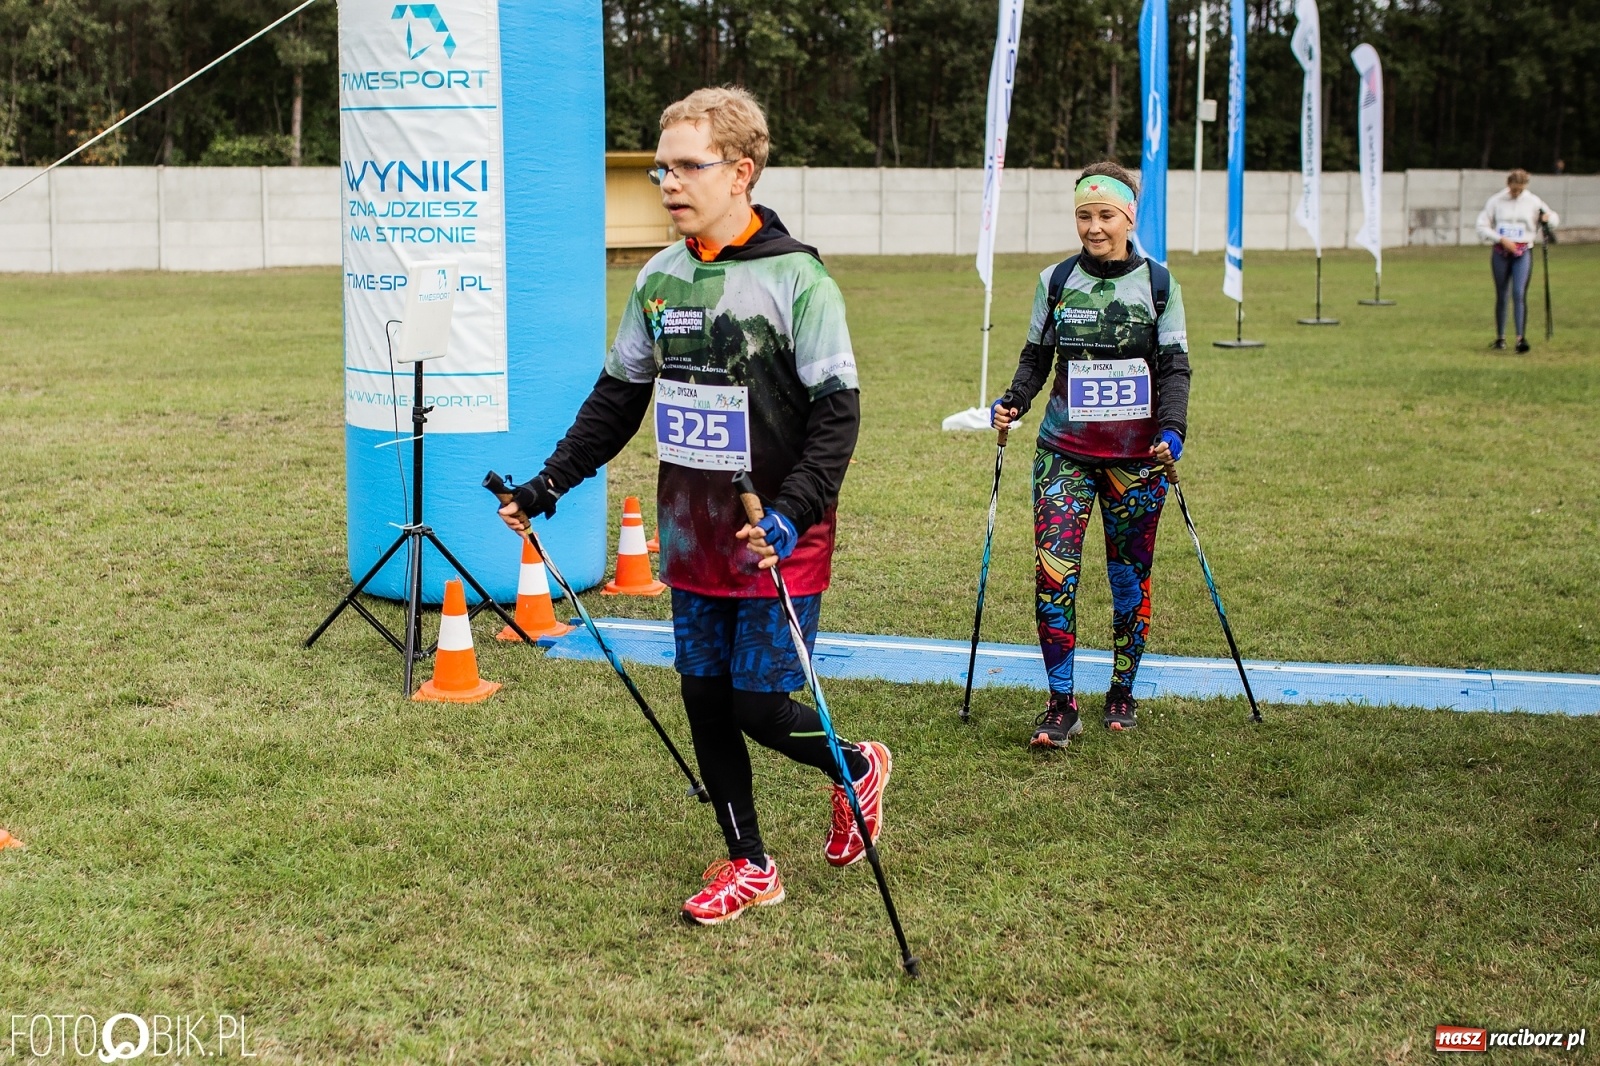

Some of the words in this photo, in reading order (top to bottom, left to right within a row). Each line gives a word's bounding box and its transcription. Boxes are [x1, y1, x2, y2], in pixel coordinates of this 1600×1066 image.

[342, 70, 490, 91] TIMESPORT
[344, 160, 488, 192] WYNIKI
[349, 201, 478, 218] ZNAJDZIESZ
[351, 226, 371, 242] NA
[376, 227, 476, 243] STRONIE
[346, 273, 492, 291] TIME-SP.PL
[419, 292, 451, 301] TIMESPORT
[1092, 363, 1113, 371] DYSZKA
[677, 386, 698, 398] DYSZKA
[1082, 380, 1137, 406] 333
[693, 399, 697, 408] Z
[697, 400, 711, 409] KIJA
[667, 409, 729, 449] 325
